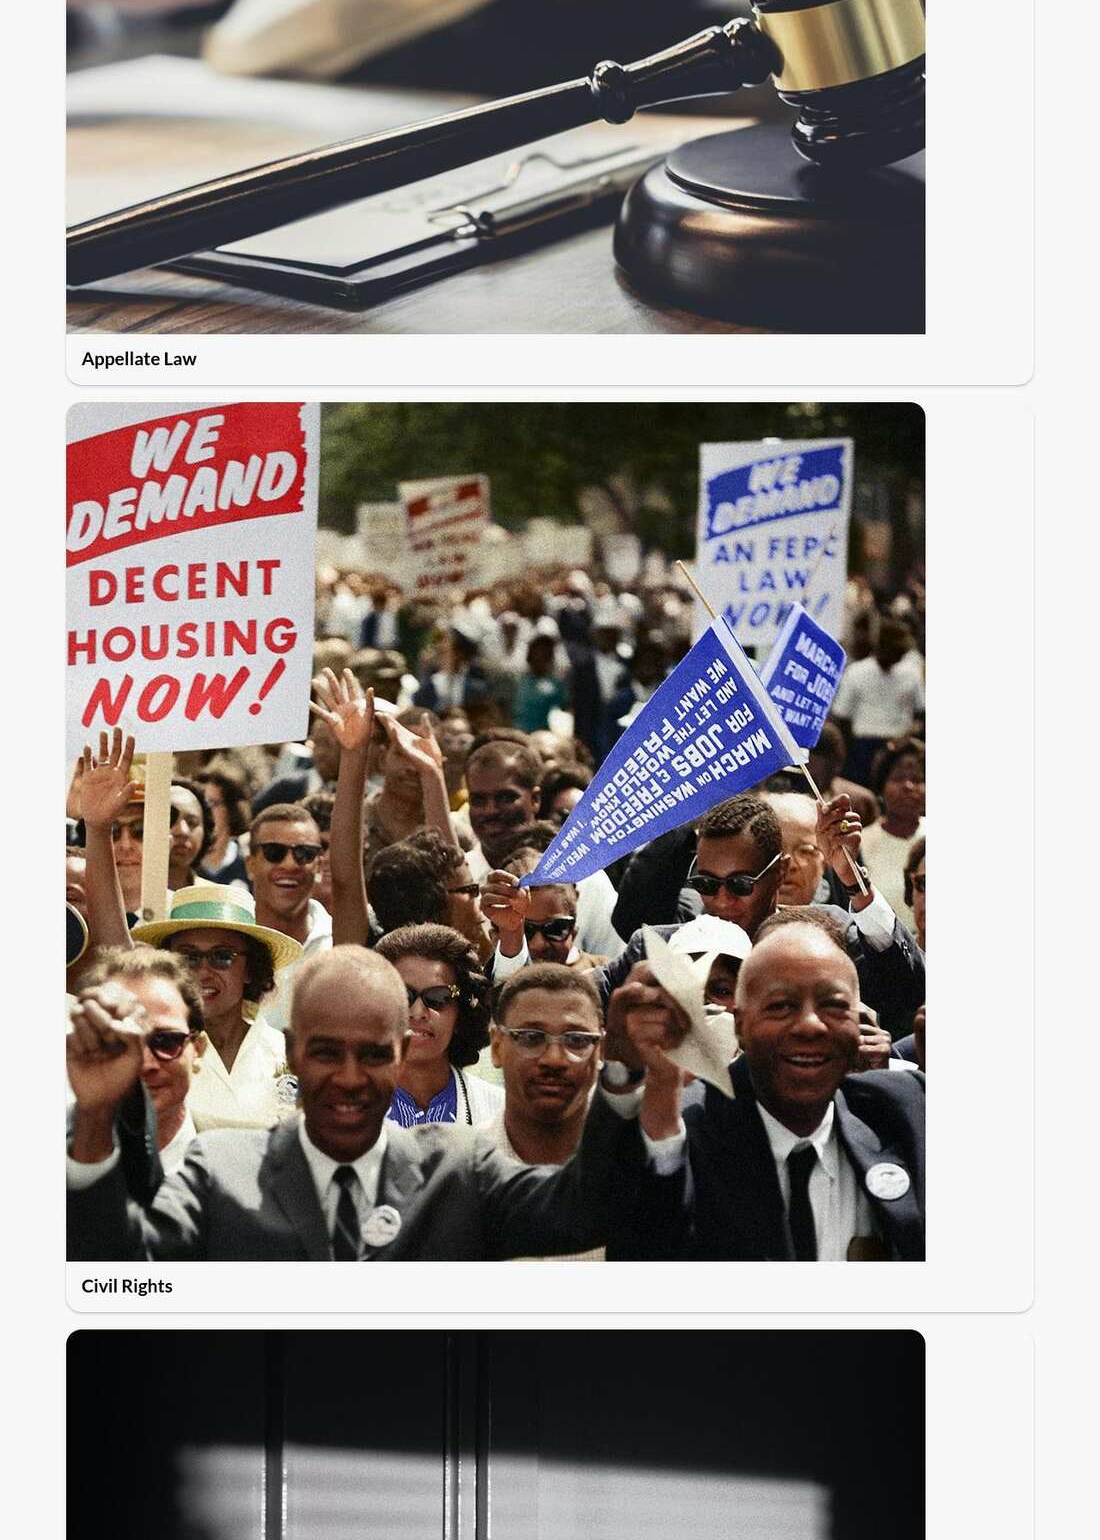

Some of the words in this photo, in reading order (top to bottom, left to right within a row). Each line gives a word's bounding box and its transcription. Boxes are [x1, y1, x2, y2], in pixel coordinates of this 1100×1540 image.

[81, 350, 161, 370] Appellate
[164, 351, 198, 367] Law
[130, 415, 225, 479] WE
[66, 451, 298, 552] DEMAND
[714, 542, 754, 563] AN
[89, 560, 281, 607] DECENT
[739, 570, 810, 592] LAW
[68, 618, 298, 666] HOUSING
[706, 658, 729, 684] WE
[784, 660, 810, 684] FOR
[82, 659, 286, 728] NOW!
[674, 680, 711, 721] WANT
[717, 676, 739, 704] AND
[771, 685, 795, 703] AND
[794, 694, 810, 710] LET
[697, 699, 718, 726] LET
[725, 703, 755, 733] FOR
[784, 709, 812, 728] WANT
[675, 719, 696, 745] THE
[591, 717, 677, 813] FREEDOM
[672, 724, 725, 778] JOBS
[710, 729, 773, 781] MARCH
[622, 744, 676, 795] WORLD
[698, 772, 712, 786] ON
[589, 779, 664, 845] FREEDOM
[590, 791, 626, 829] KNOW
[607, 781, 699, 846] WASHINGTON
[561, 827, 581, 849] WAS
[81, 1277, 118, 1294] Civil
[121, 1277, 173, 1297] Rights
